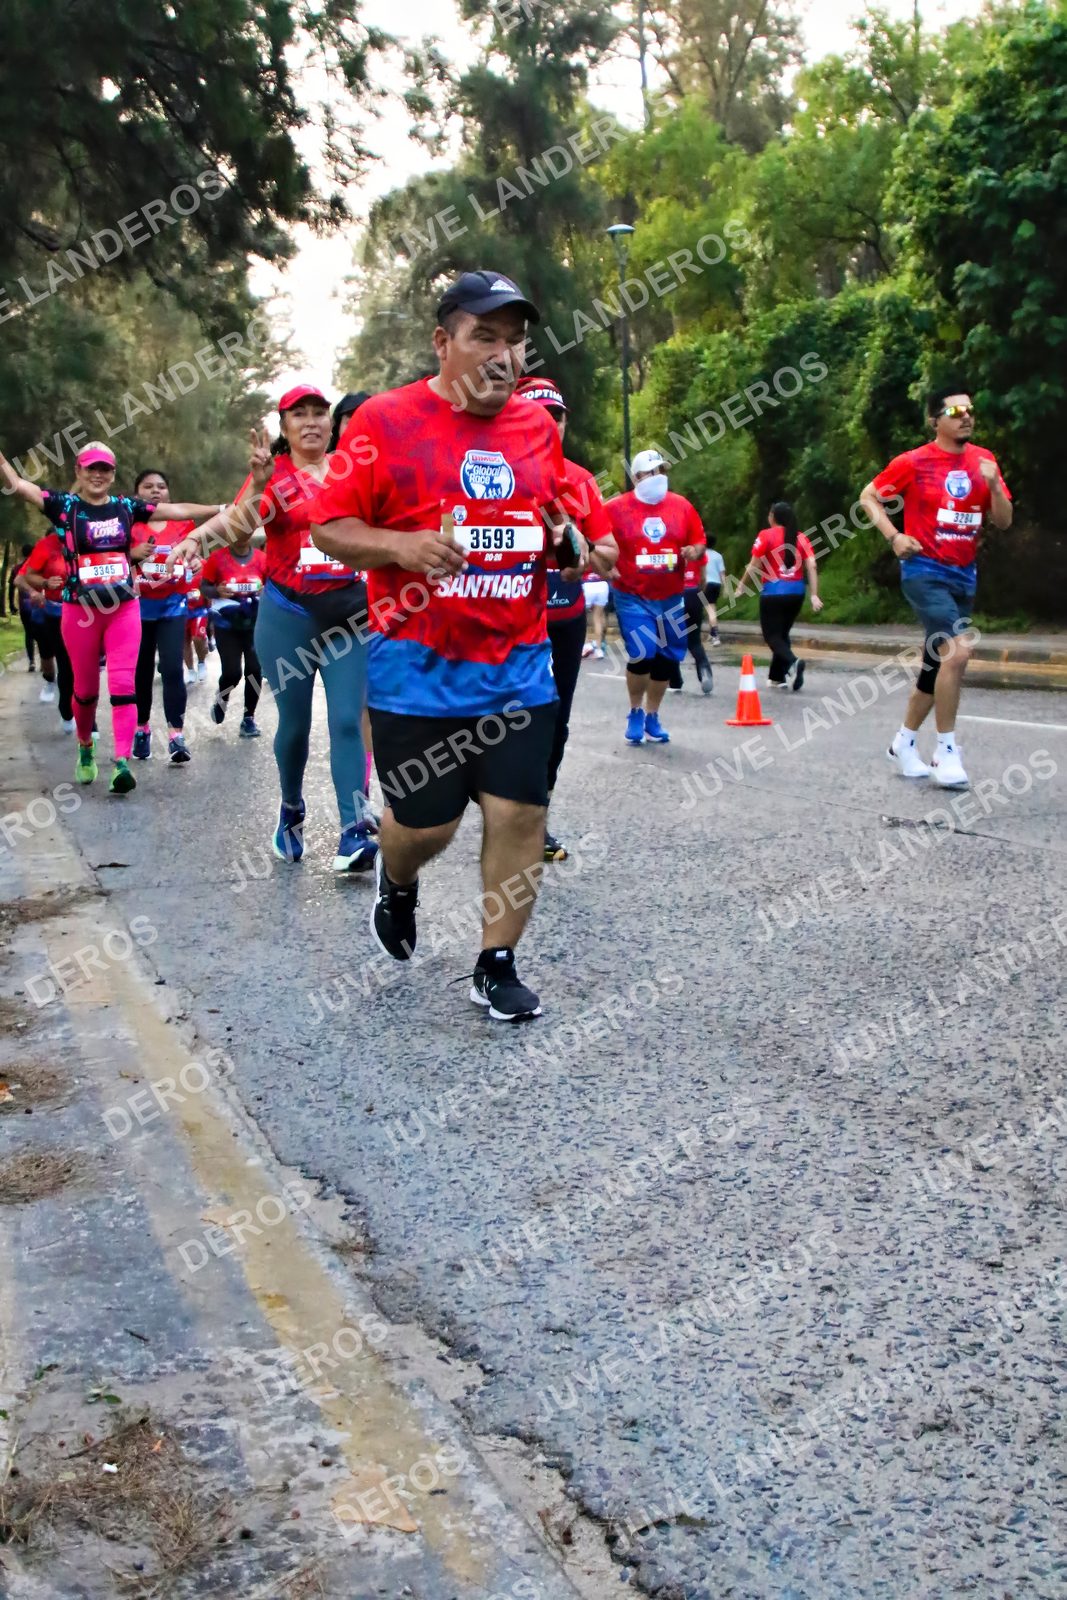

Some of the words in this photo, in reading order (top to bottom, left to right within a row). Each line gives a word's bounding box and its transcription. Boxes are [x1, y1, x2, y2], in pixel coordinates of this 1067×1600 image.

[473, 465, 501, 477] Global
[469, 474, 490, 485] Race
[470, 528, 515, 549] 3593
[93, 565, 116, 576] 3345
[438, 574, 533, 599] SANTIAGO
